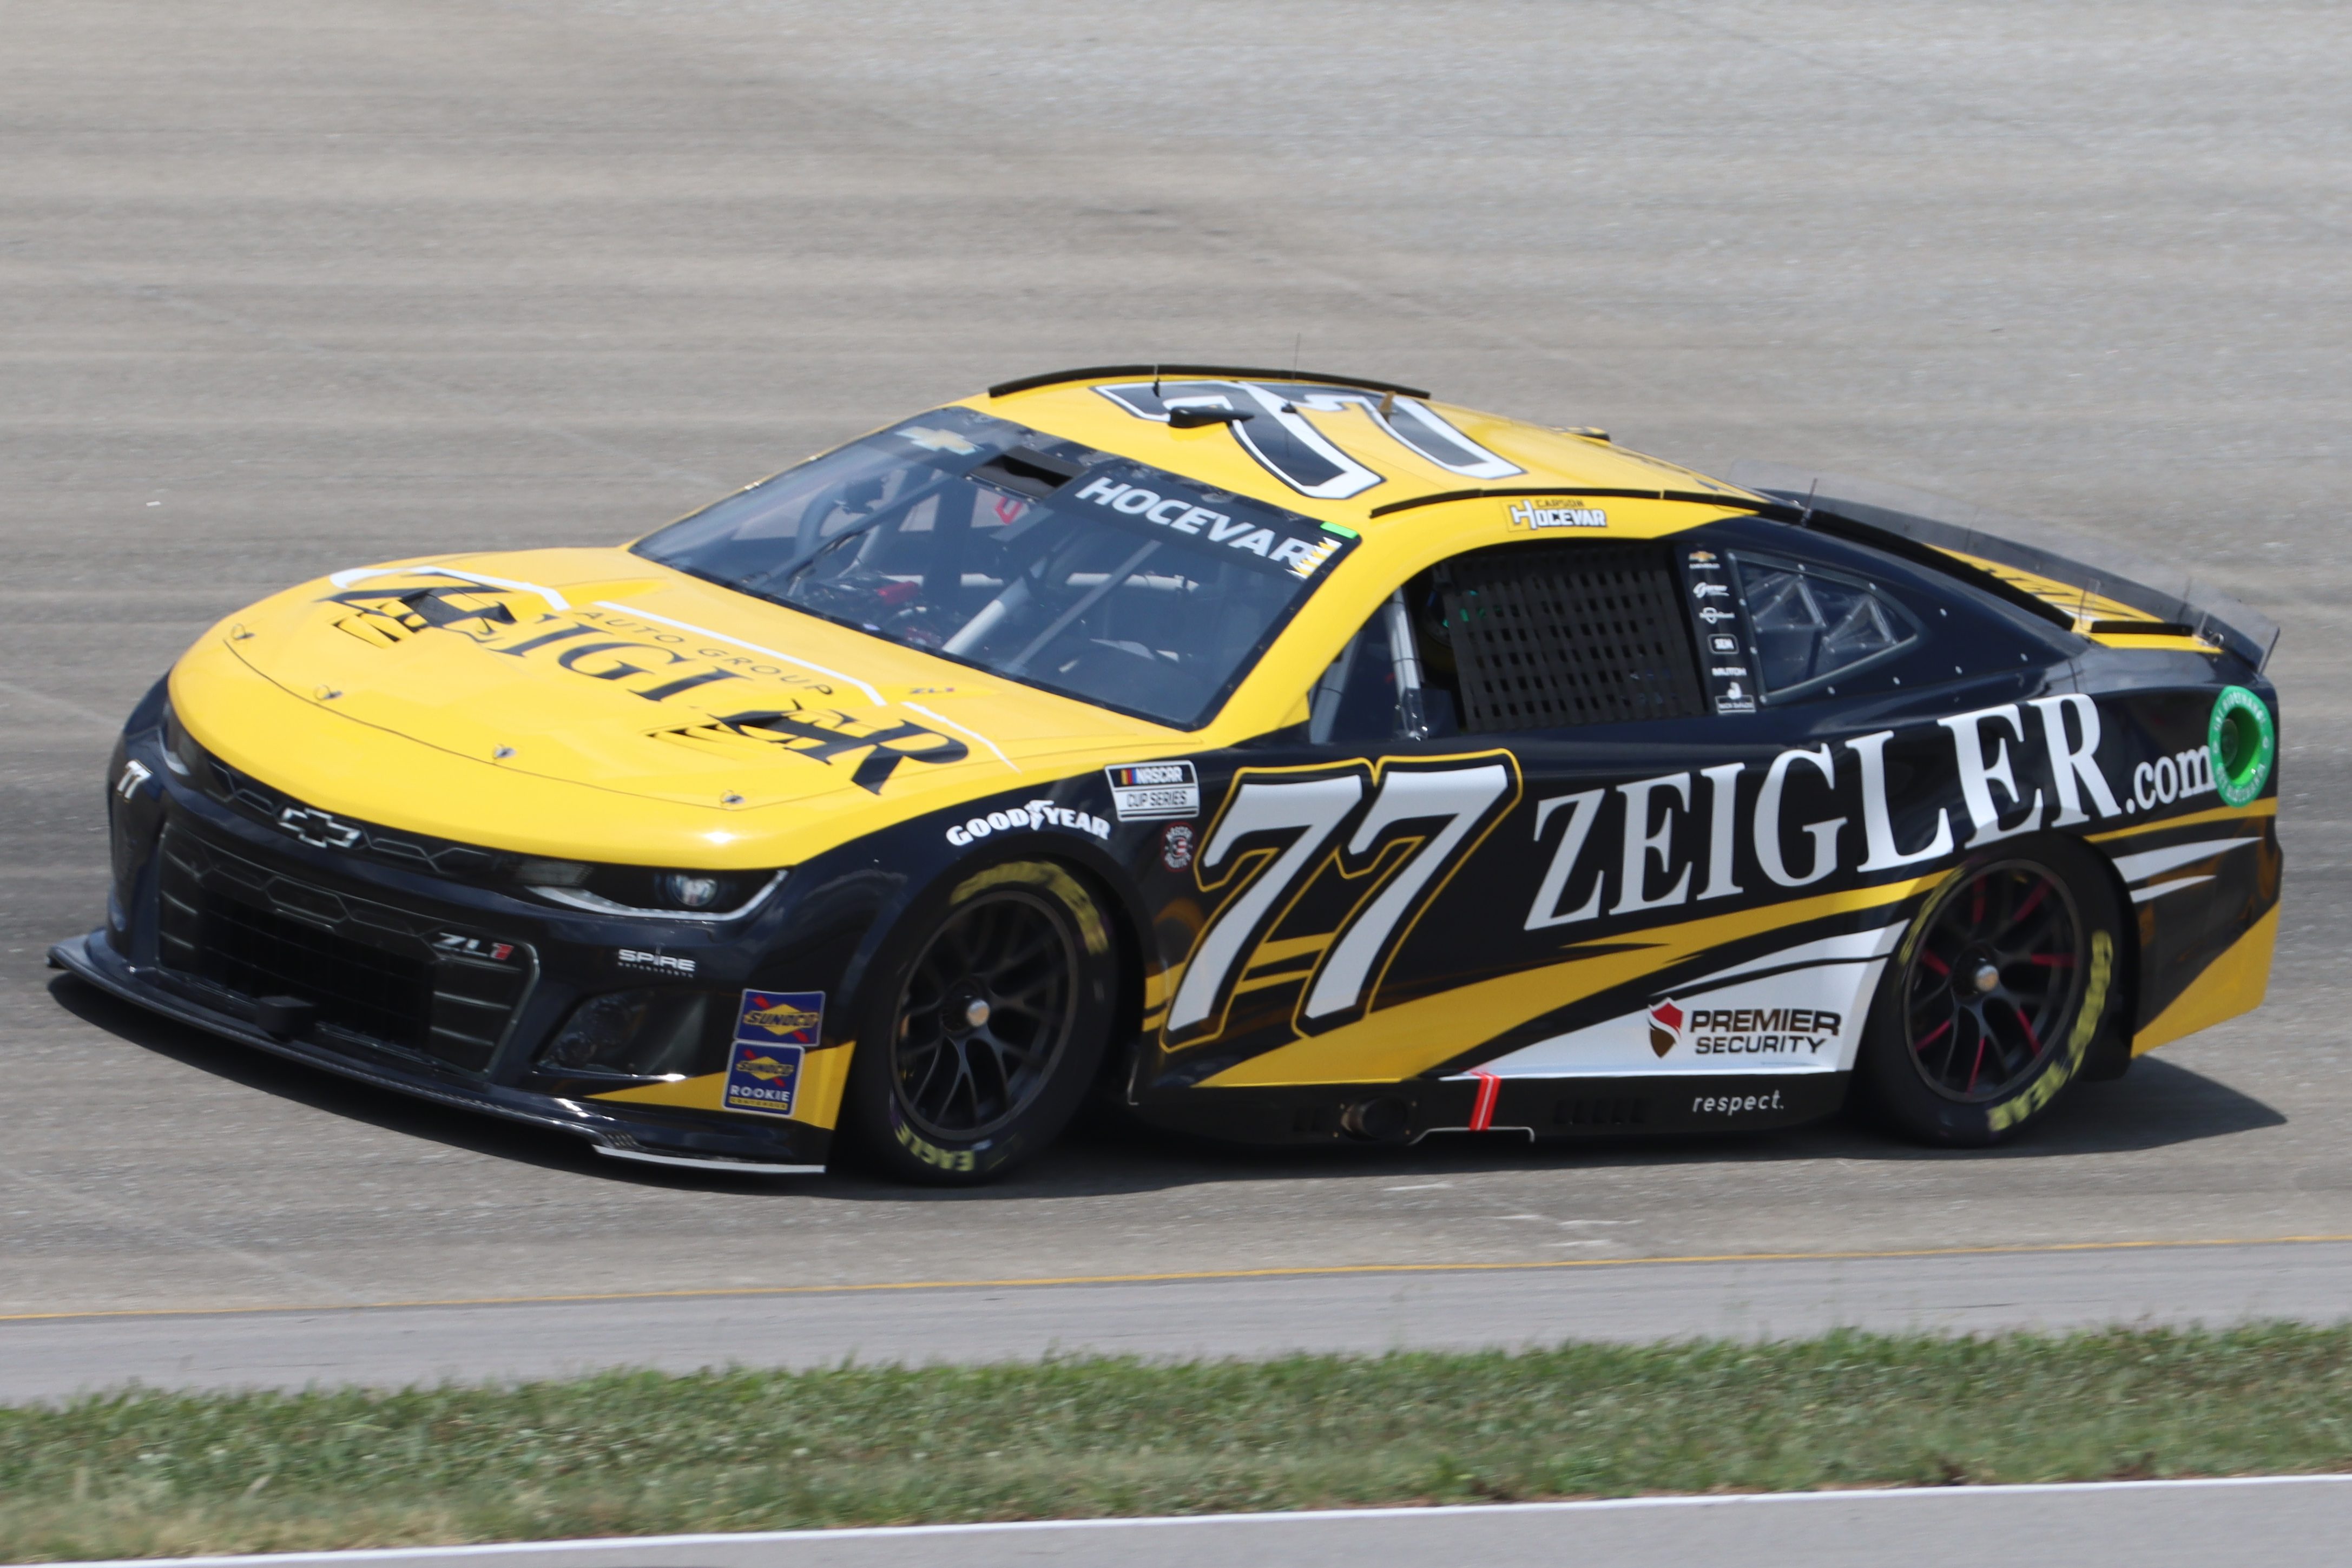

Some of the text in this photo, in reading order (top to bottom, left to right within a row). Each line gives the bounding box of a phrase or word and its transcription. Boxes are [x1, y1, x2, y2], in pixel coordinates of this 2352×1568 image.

[1075, 477, 1316, 568] HOCEVAR
[1510, 499, 1607, 530] HOCEVAR
[574, 611, 834, 696] AUTO GROUP
[1136, 766, 1183, 784] NASCAR
[1127, 790, 1187, 807] CUP SERIES
[946, 802, 1111, 846] GOODYEAR
[1167, 764, 1508, 1032] 77
[432, 932, 514, 960] ZL1
[618, 947, 696, 972] SPIRE
[745, 1010, 820, 1027] SUNOCO
[1689, 1008, 1842, 1036] PREMIER
[1695, 1035, 1827, 1055] SECURITY
[730, 1084, 790, 1102] ROOKIE
[1692, 1089, 1784, 1116] respect.
